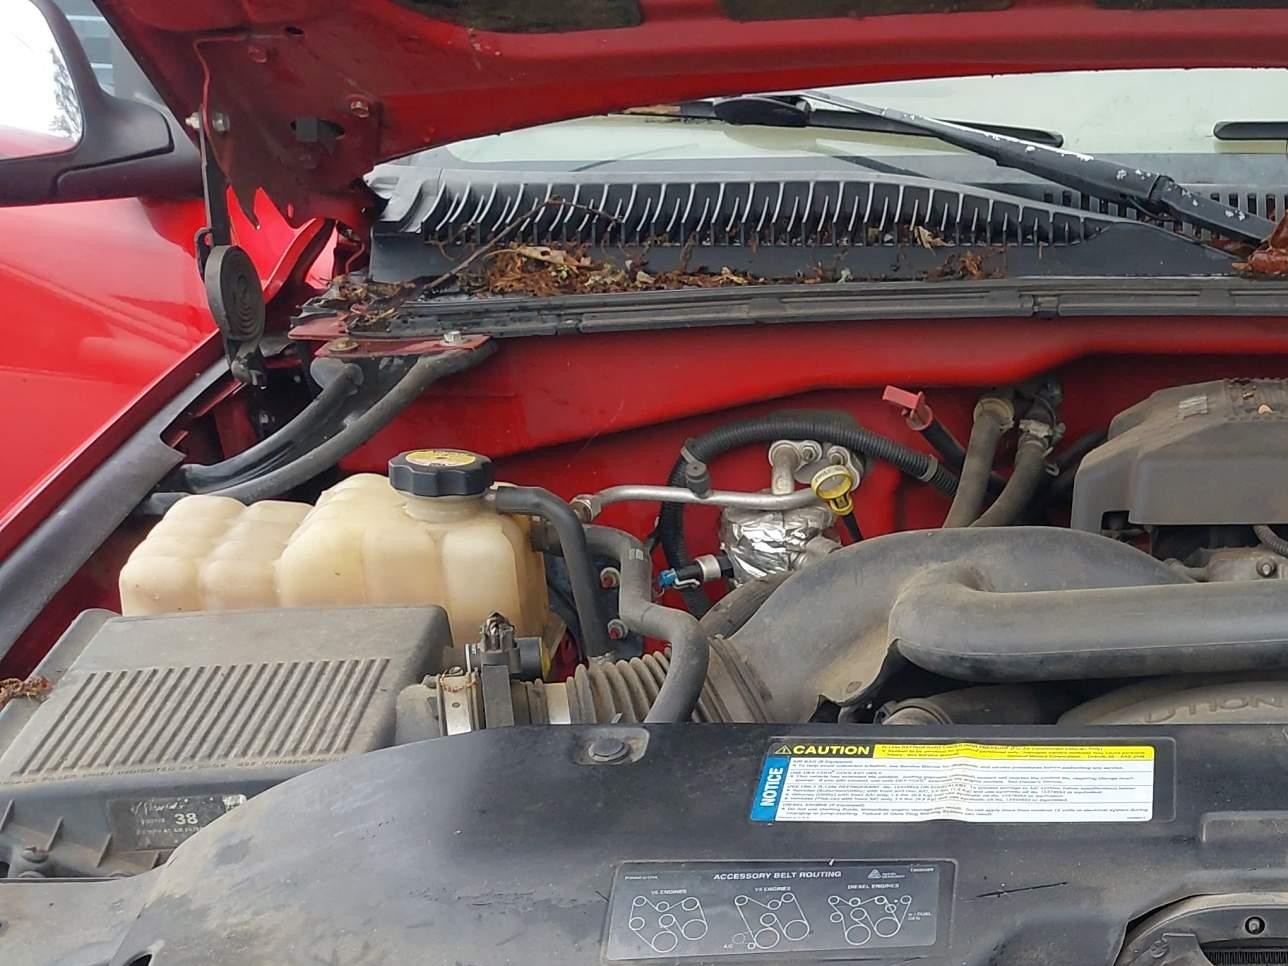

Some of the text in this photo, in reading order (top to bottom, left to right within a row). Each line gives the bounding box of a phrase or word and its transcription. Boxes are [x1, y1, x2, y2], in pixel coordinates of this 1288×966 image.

[793, 745, 870, 755] CAUTION
[760, 767, 784, 807] NOTICE
[174, 812, 199, 825] 38
[713, 870, 842, 880] ACCESSORY BELT ROUTING
